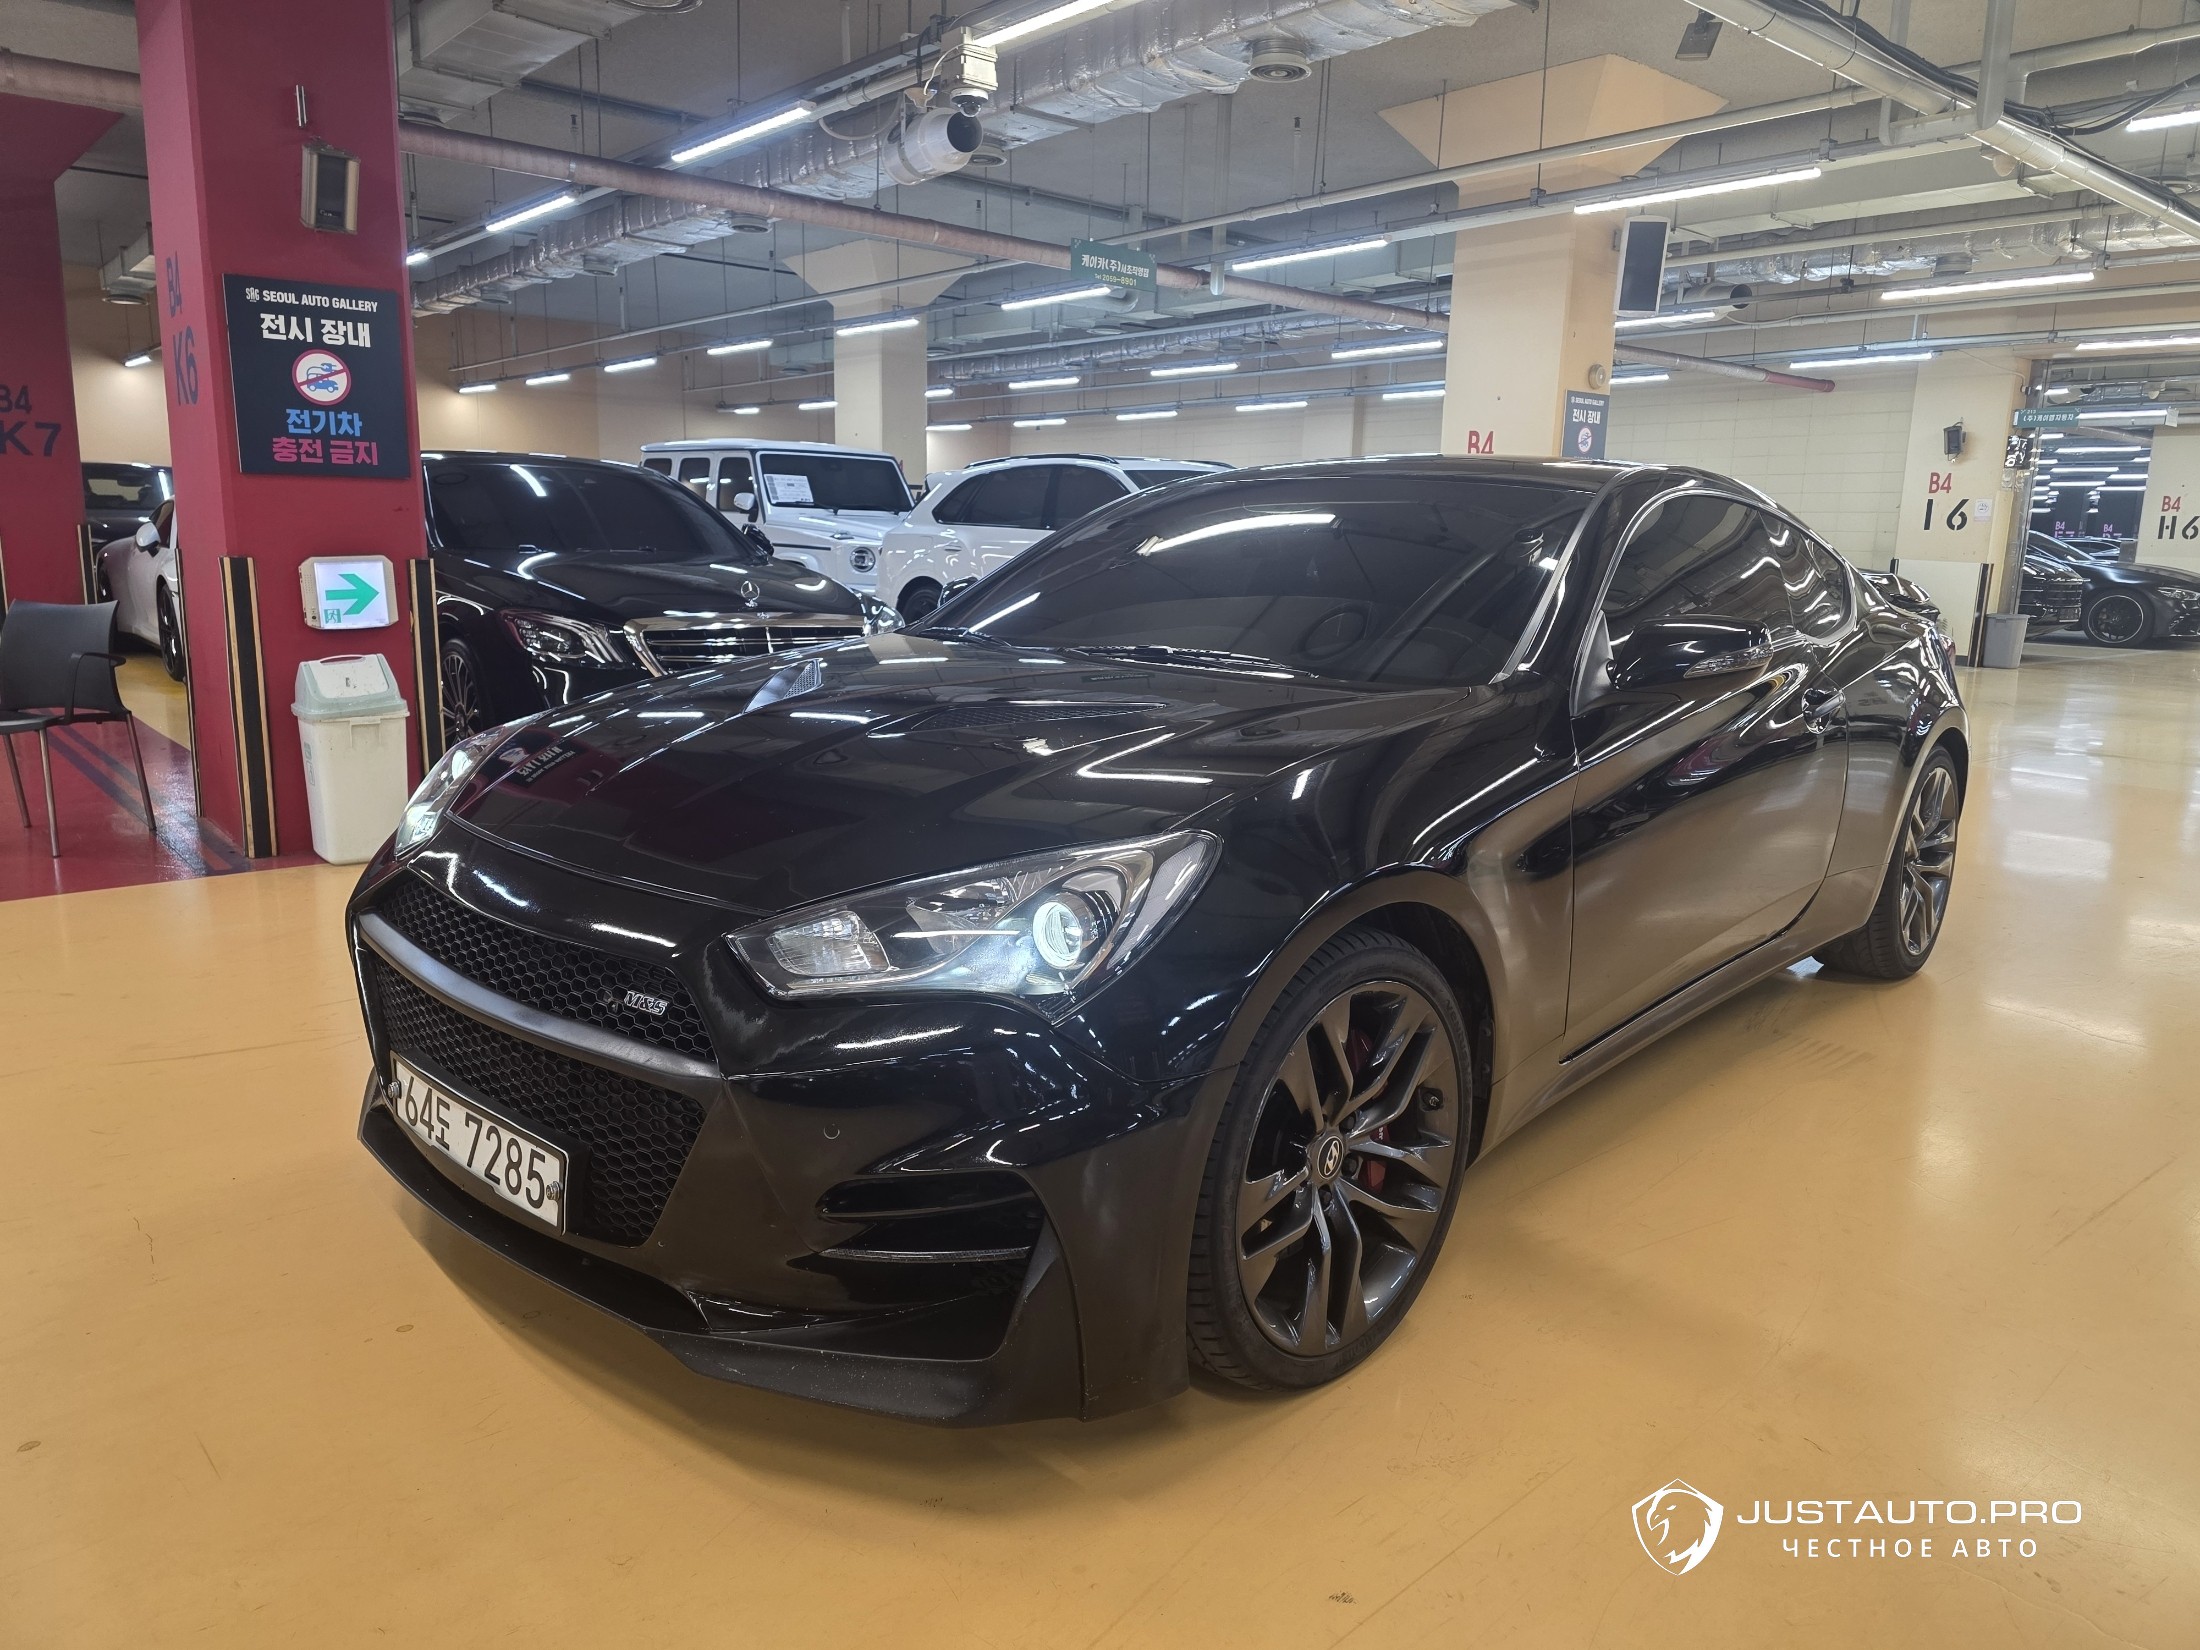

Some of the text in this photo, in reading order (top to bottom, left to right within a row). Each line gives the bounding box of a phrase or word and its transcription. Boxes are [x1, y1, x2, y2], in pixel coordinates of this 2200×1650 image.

[166, 251, 182, 318] B4
[1102, 274, 1137, 286] 2059-8901
[262, 290, 300, 305] SEOUL
[301, 294, 330, 308] AUTO
[331, 297, 378, 313] GALLERY
[260, 313, 372, 348] 전시 장내
[172, 325, 199, 406] K6
[285, 408, 363, 437] 전기차
[1572, 408, 1601, 425] 전시 장내
[0, 420, 62, 457] K7
[1467, 430, 1495, 454] B4
[272, 436, 379, 466] 충전 금지
[1928, 472, 1952, 494] B4
[2161, 495, 2182, 512] B4
[2055, 521, 2066, 530] B4
[2103, 524, 2113, 533] B4
[2157, 515, 2200, 540] H6
[404, 1075, 546, 1210] 64도 7285
